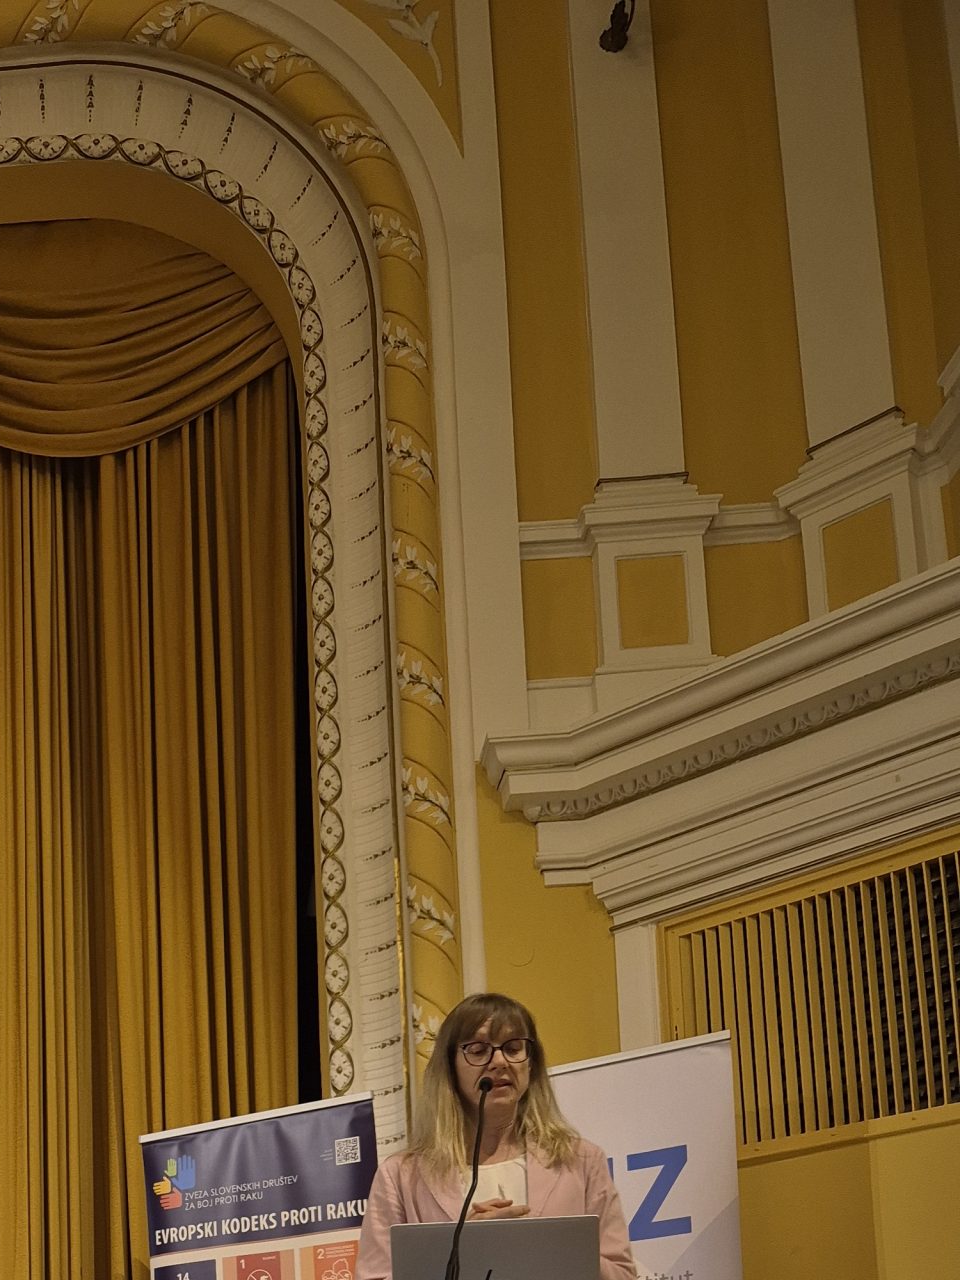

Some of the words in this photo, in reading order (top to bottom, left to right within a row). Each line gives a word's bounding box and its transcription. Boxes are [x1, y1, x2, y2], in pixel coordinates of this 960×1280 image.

[185, 1189, 209, 1201] ZVEZA
[210, 1182, 261, 1197] SLOVENSKIH
[262, 1174, 298, 1191] DRUŠTEV
[607, 1144, 692, 1241] Z
[185, 1202, 197, 1211] ZA
[198, 1199, 213, 1209] BOJ
[214, 1195, 239, 1206] PROTI
[240, 1191, 264, 1202] RAKU
[155, 1221, 217, 1246] EVROPSKI
[221, 1212, 277, 1236] KODEKS
[281, 1206, 322, 1227] PROTI
[326, 1198, 368, 1220] RAKU
[239, 1259, 246, 1270] 1
[316, 1248, 325, 1259] 2
